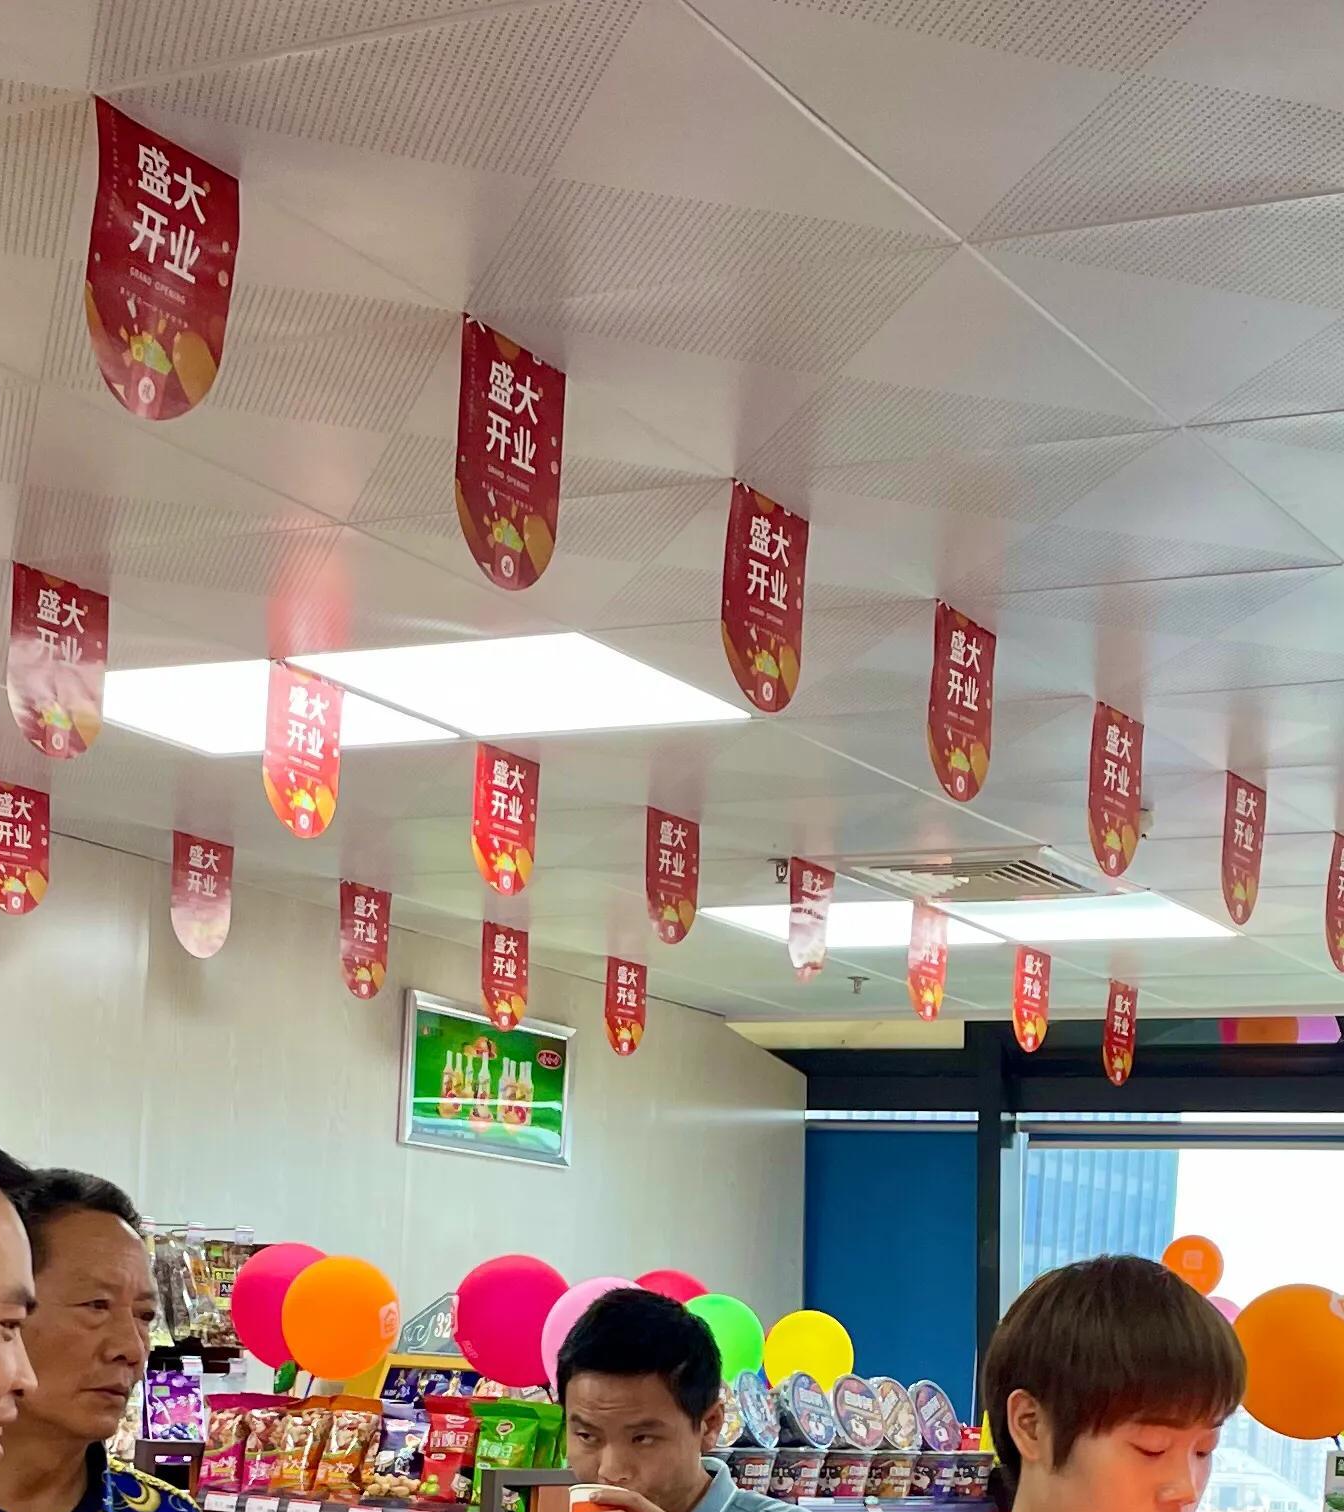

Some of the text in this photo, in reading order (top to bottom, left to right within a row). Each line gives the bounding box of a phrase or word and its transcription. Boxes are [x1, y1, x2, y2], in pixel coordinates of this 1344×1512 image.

[136, 146, 206, 224] 盛大
[129, 205, 199, 286] 开业
[489, 361, 539, 423] 盛大
[486, 409, 536, 475] 开业
[749, 516, 789, 566] 盛大
[747, 559, 788, 614] 开业
[37, 588, 85, 634] 盛大
[951, 629, 982, 673] 盛大
[947, 669, 979, 713] 开业
[287, 715, 325, 759] 开业
[1106, 724, 1134, 763] 盛大
[493, 760, 525, 795] 盛大
[1104, 758, 1131, 798] 开业
[491, 789, 523, 825] 开业
[1236, 787, 1258, 820] 盛大
[660, 819, 688, 848] 盛大
[1233, 819, 1255, 852] 开业
[189, 845, 219, 873] 盛大
[658, 849, 686, 878] 开业
[187, 871, 217, 898] 开业
[354, 896, 379, 920] 盛大
[353, 918, 378, 943] 开业
[494, 934, 517, 957] 盛大
[492, 956, 517, 979] 开业
[618, 966, 638, 986] 盛大
[1026, 953, 1044, 977] 盛大
[617, 986, 638, 1008] 开业
